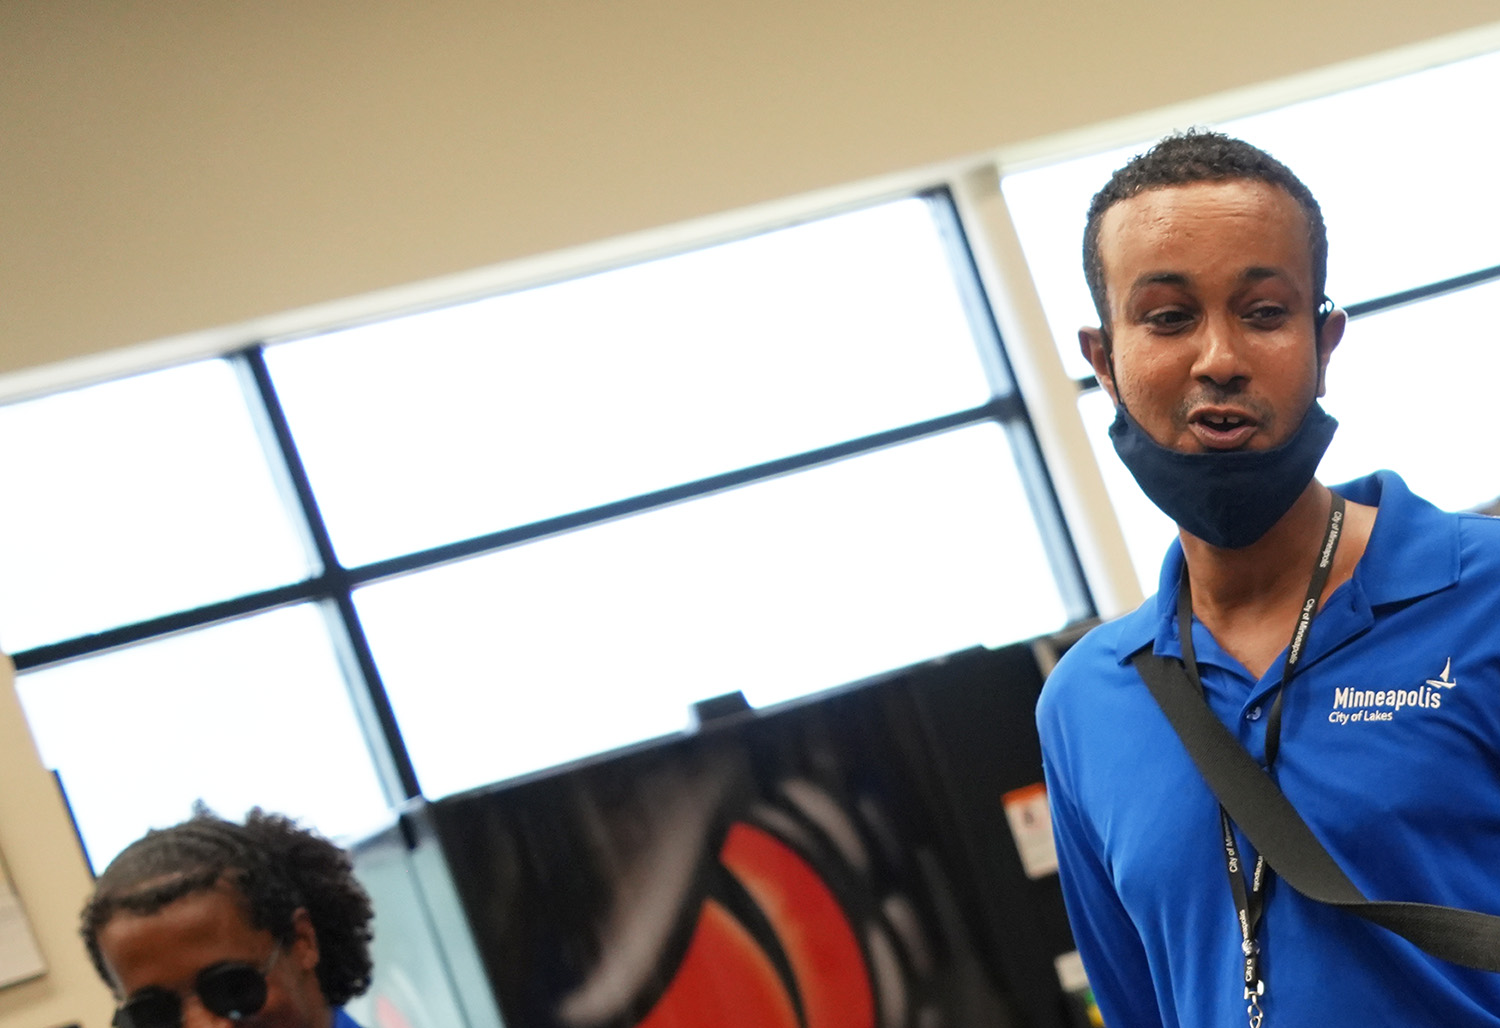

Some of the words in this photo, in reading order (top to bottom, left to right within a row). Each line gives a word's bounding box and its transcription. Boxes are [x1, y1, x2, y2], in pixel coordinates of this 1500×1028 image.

[1332, 511, 1342, 523] City
[1331, 522, 1339, 531] of
[1319, 530, 1339, 568] Minneapolis
[1303, 598, 1315, 612] City
[1302, 611, 1310, 621] of
[1289, 620, 1309, 665] Minneapolis
[1333, 686, 1442, 711] Minneapolis
[1328, 711, 1348, 726] City
[1350, 710, 1364, 722] of
[1364, 709, 1393, 722] Lakes
[1229, 856, 1238, 873] City
[1245, 966, 1254, 982] City
